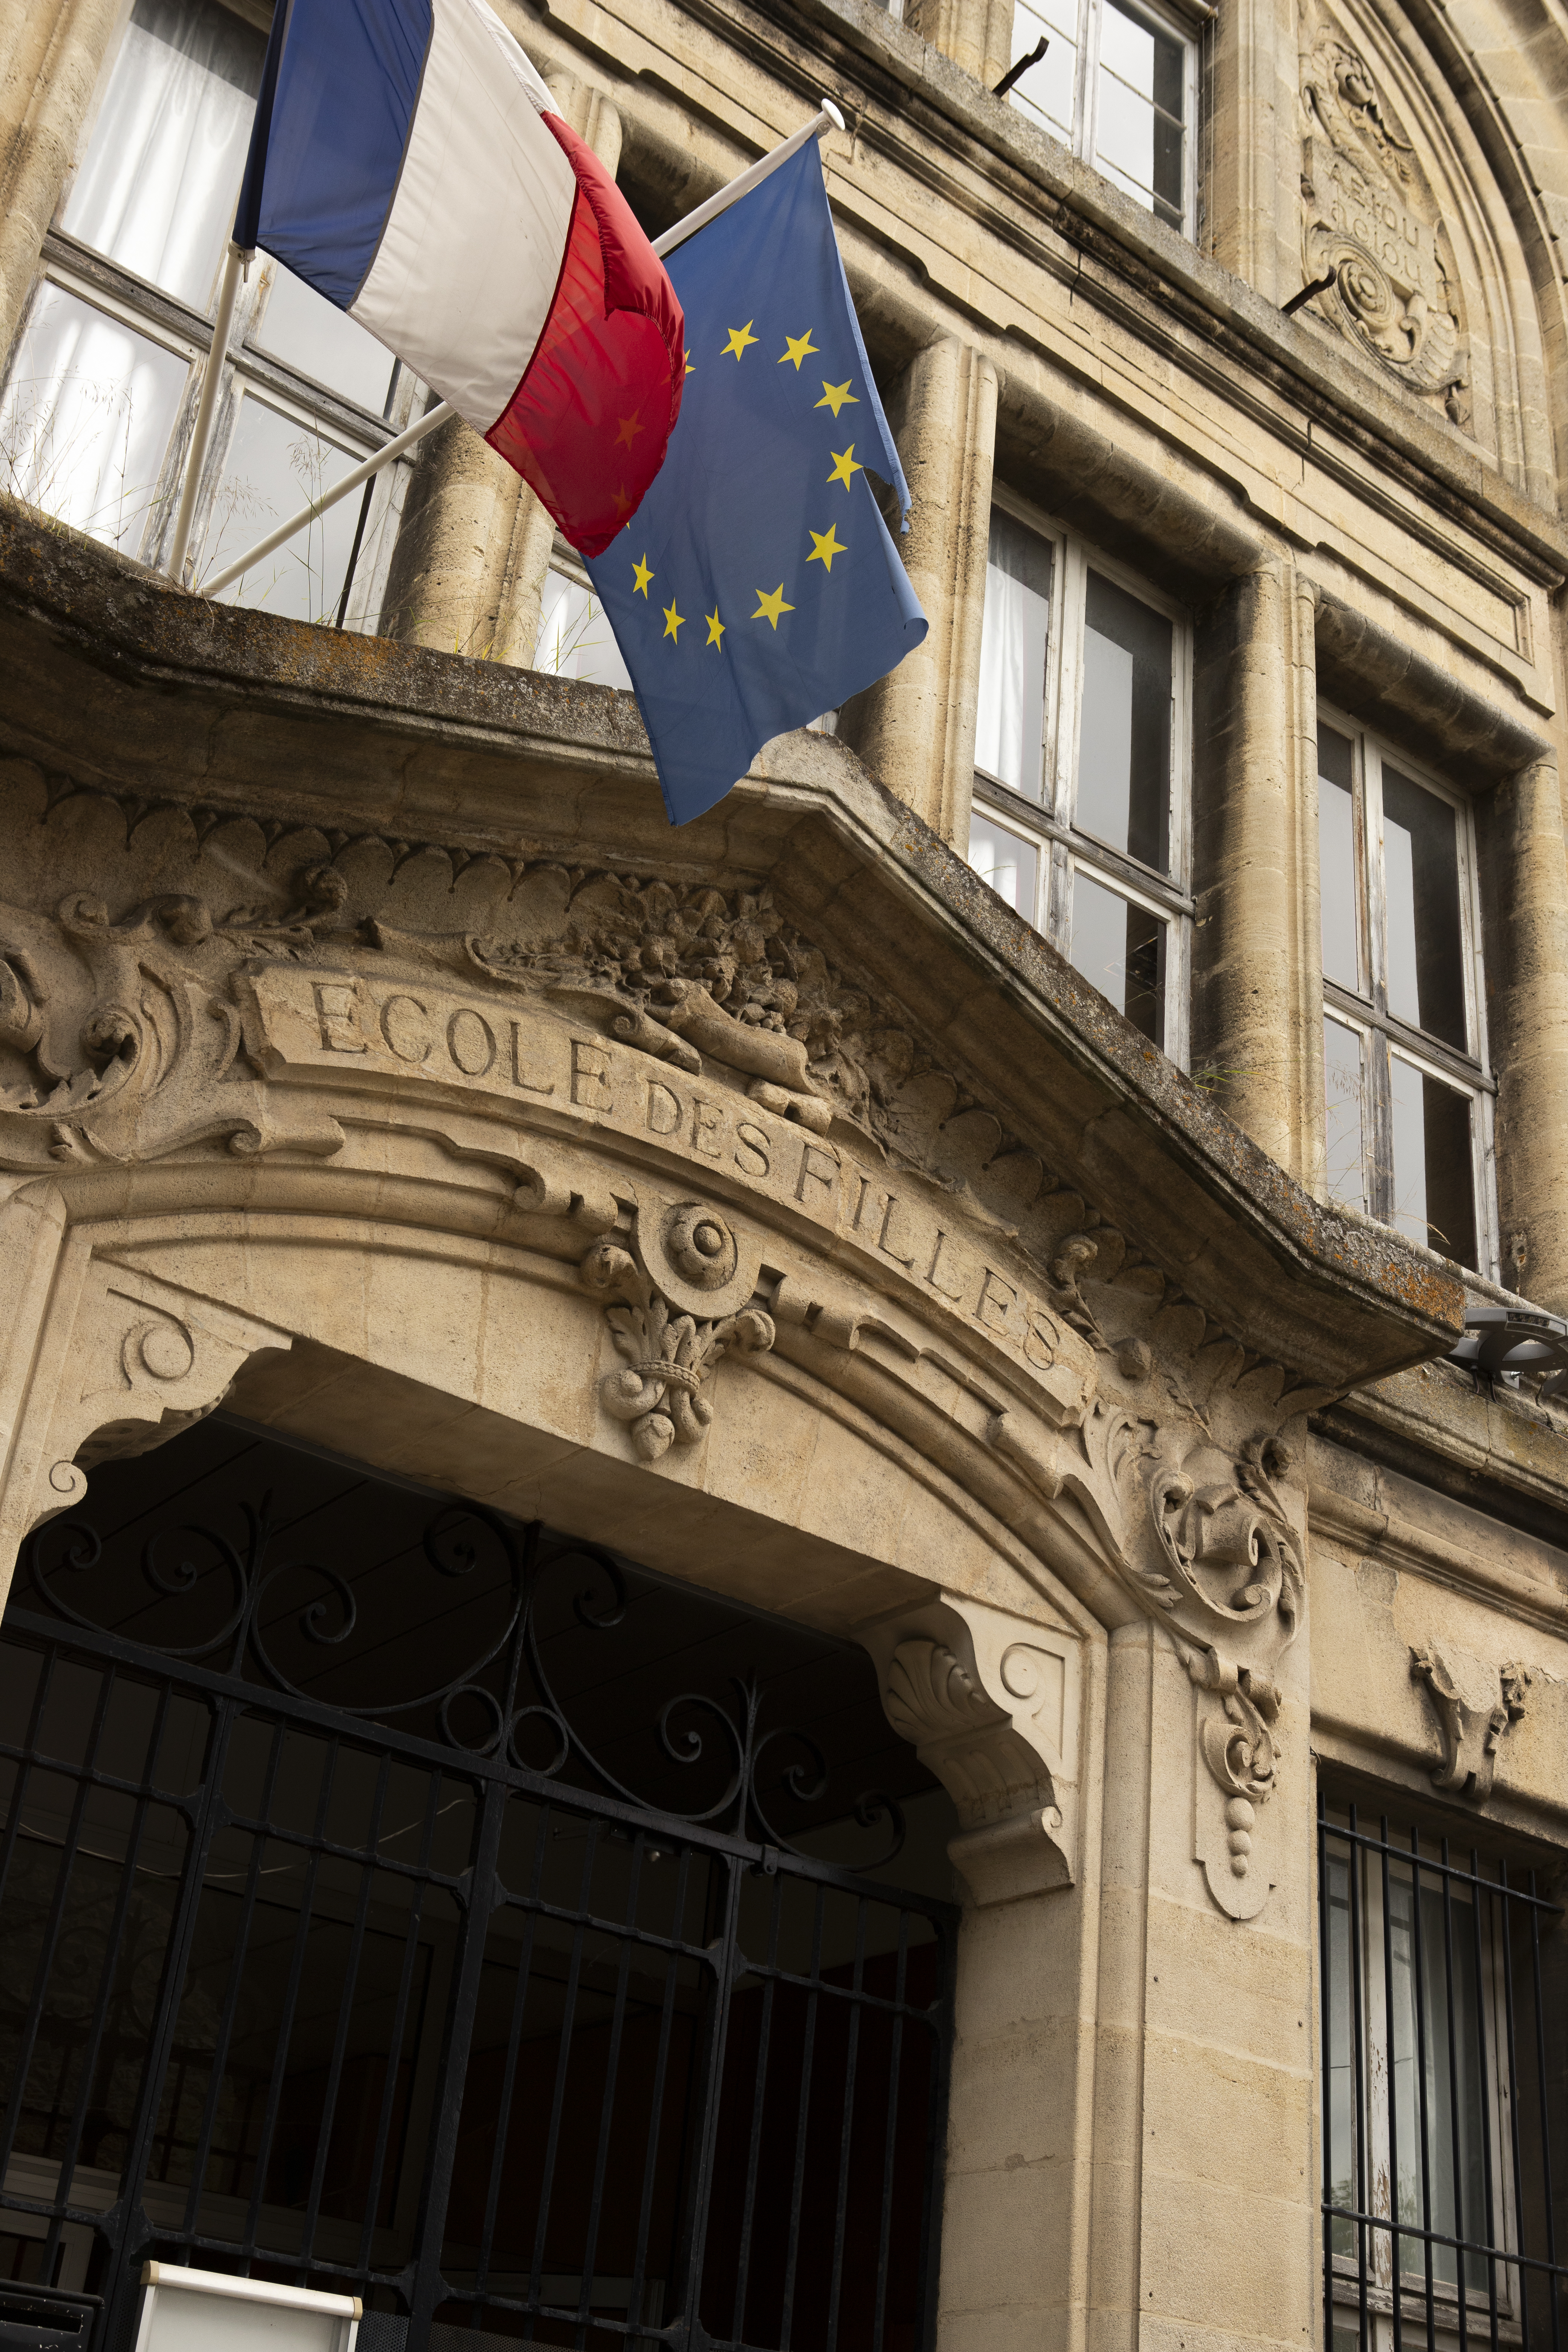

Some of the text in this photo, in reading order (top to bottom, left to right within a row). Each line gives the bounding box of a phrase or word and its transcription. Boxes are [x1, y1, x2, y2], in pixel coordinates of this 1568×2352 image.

[311, 981, 1060, 1370] ECOLE DES FILLES
